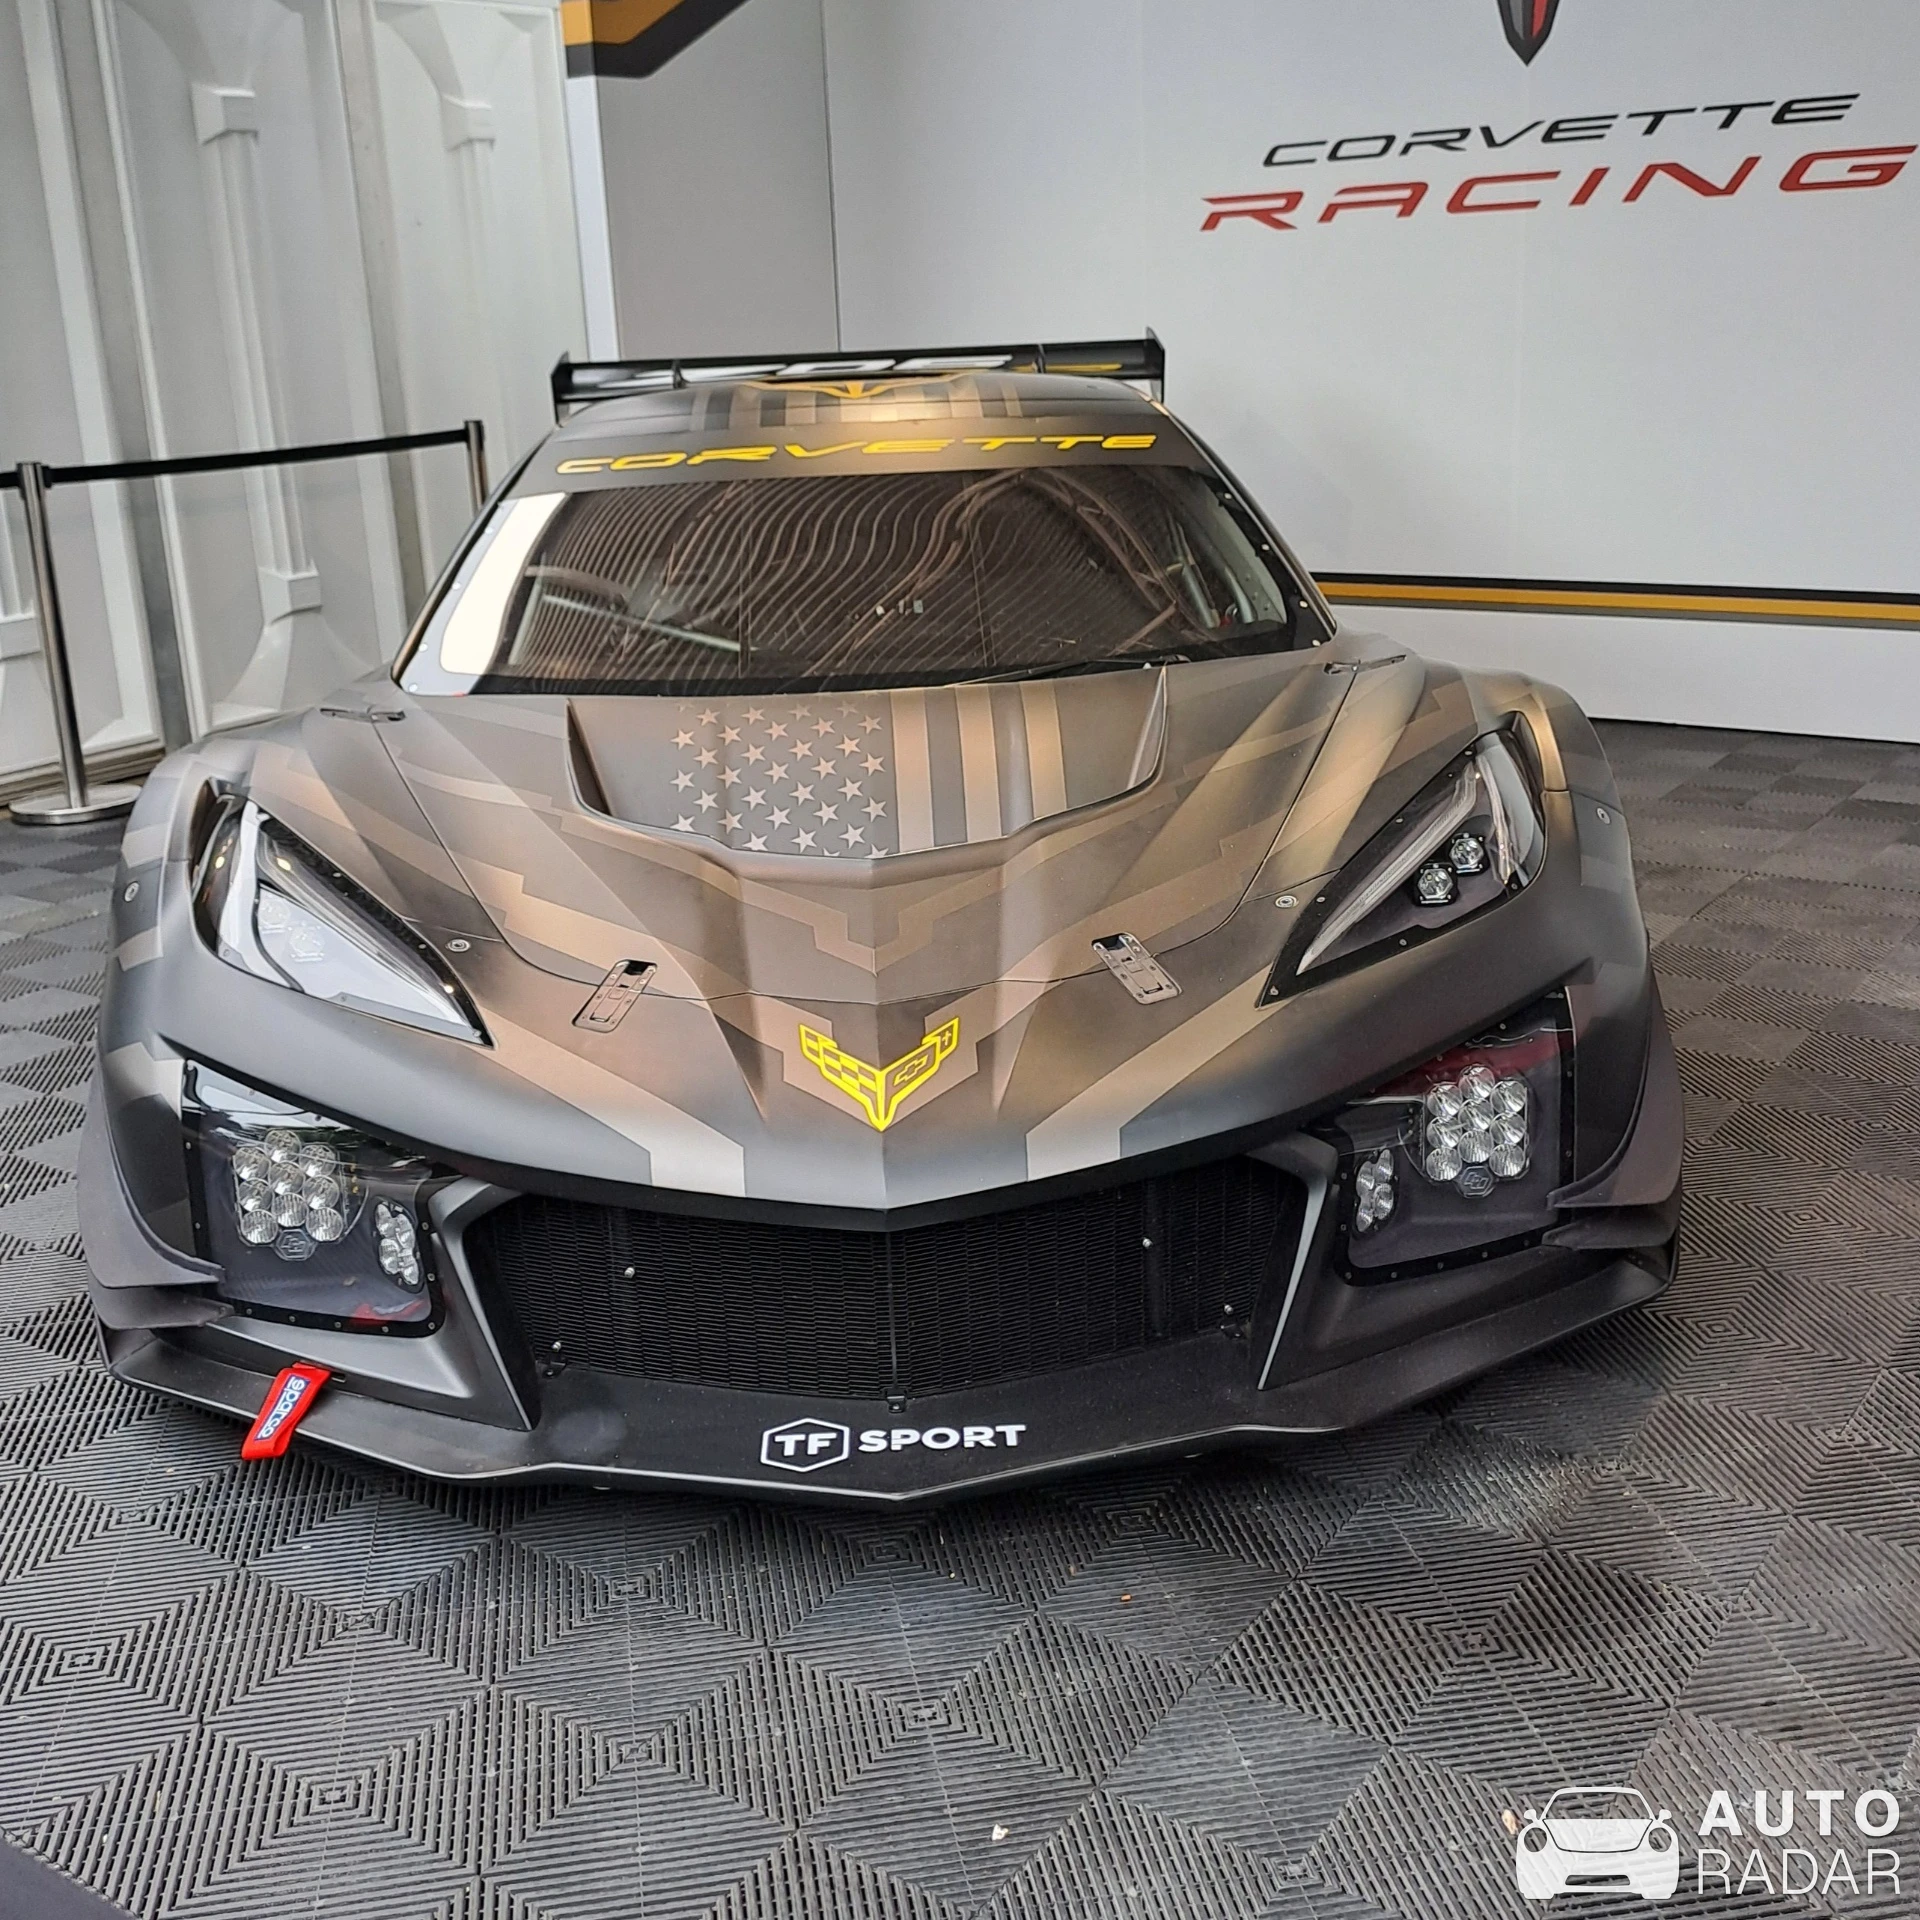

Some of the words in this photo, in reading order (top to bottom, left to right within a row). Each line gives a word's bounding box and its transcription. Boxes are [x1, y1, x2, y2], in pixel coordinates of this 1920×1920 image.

[1262, 93, 1860, 167] CORVETTE
[1199, 145, 1918, 231] RACING
[556, 434, 1157, 474] CORVETTE
[259, 1376, 305, 1439] sparco
[774, 1432, 837, 1456] TF
[857, 1424, 1026, 1452] SPORT
